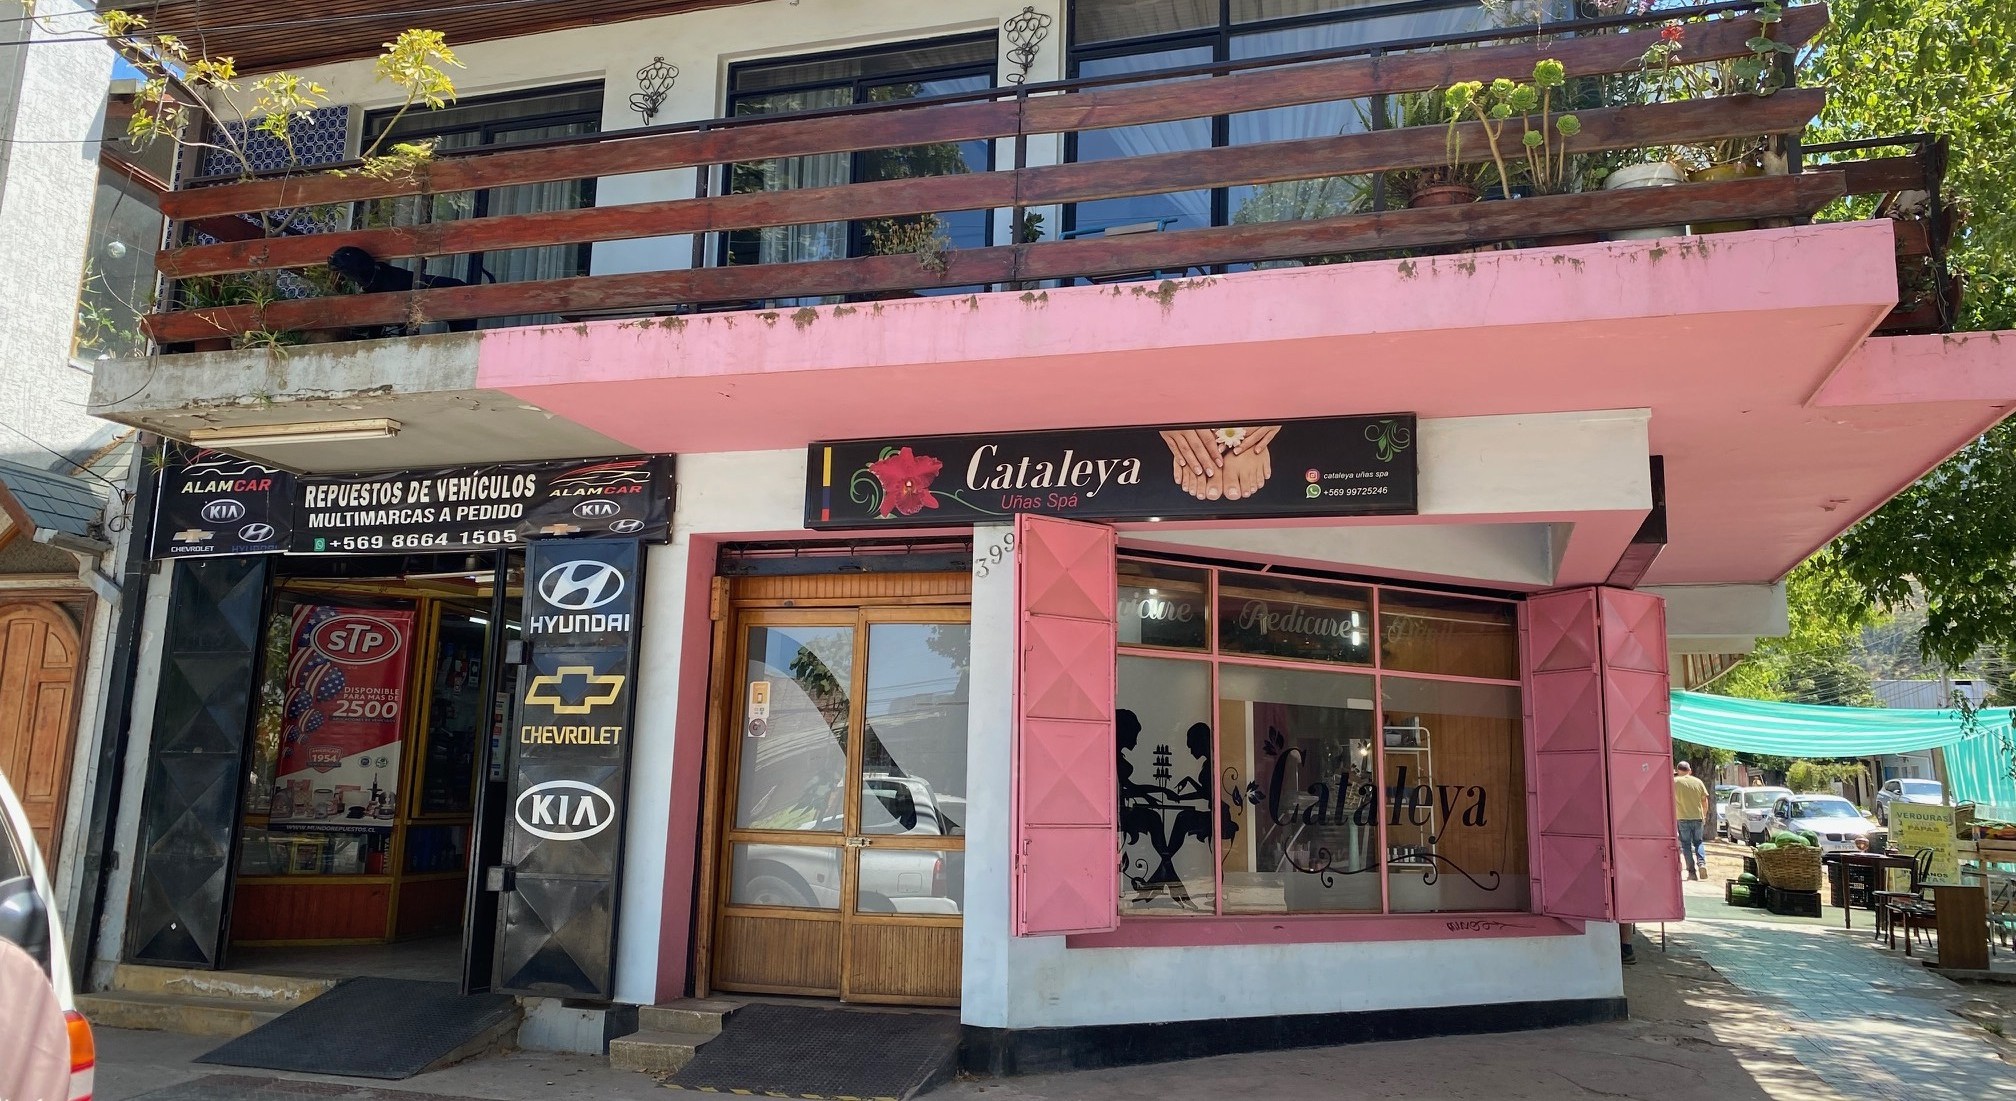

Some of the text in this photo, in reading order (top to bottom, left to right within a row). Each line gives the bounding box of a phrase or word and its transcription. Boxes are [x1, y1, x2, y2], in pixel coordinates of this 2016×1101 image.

[966, 444, 1141, 498] Cataleya
[1323, 471, 1389, 480] cataleya uñas spa
[181, 478, 272, 494] ALAMCAR
[305, 470, 536, 508] REPUESTOS DE VEHÍCULOS
[549, 485, 643, 497] ALAMCAR
[1323, 486, 1388, 497] +569 99725246
[582, 504, 613, 516] KIA
[1001, 492, 1078, 511] Uñas Spá
[209, 505, 238, 519] KIA
[308, 503, 524, 528] MULTIMARCAS A PEDIDO
[170, 545, 215, 553] CHEVROLET
[329, 529, 517, 550] +569 8664 1505
[975, 532, 1014, 578] 399
[529, 613, 630, 634] HYUNDAI
[1239, 599, 1353, 638] Pedicure
[327, 623, 384, 654] STP
[344, 686, 400, 695] DISPONIBLE
[332, 699, 398, 719] 2500
[521, 726, 623, 745] CHEVROLET
[312, 754, 337, 763] 1954
[1268, 747, 1488, 845] Cataleya
[531, 794, 598, 826] KIA
[1896, 812, 1949, 823] VERDURAS
